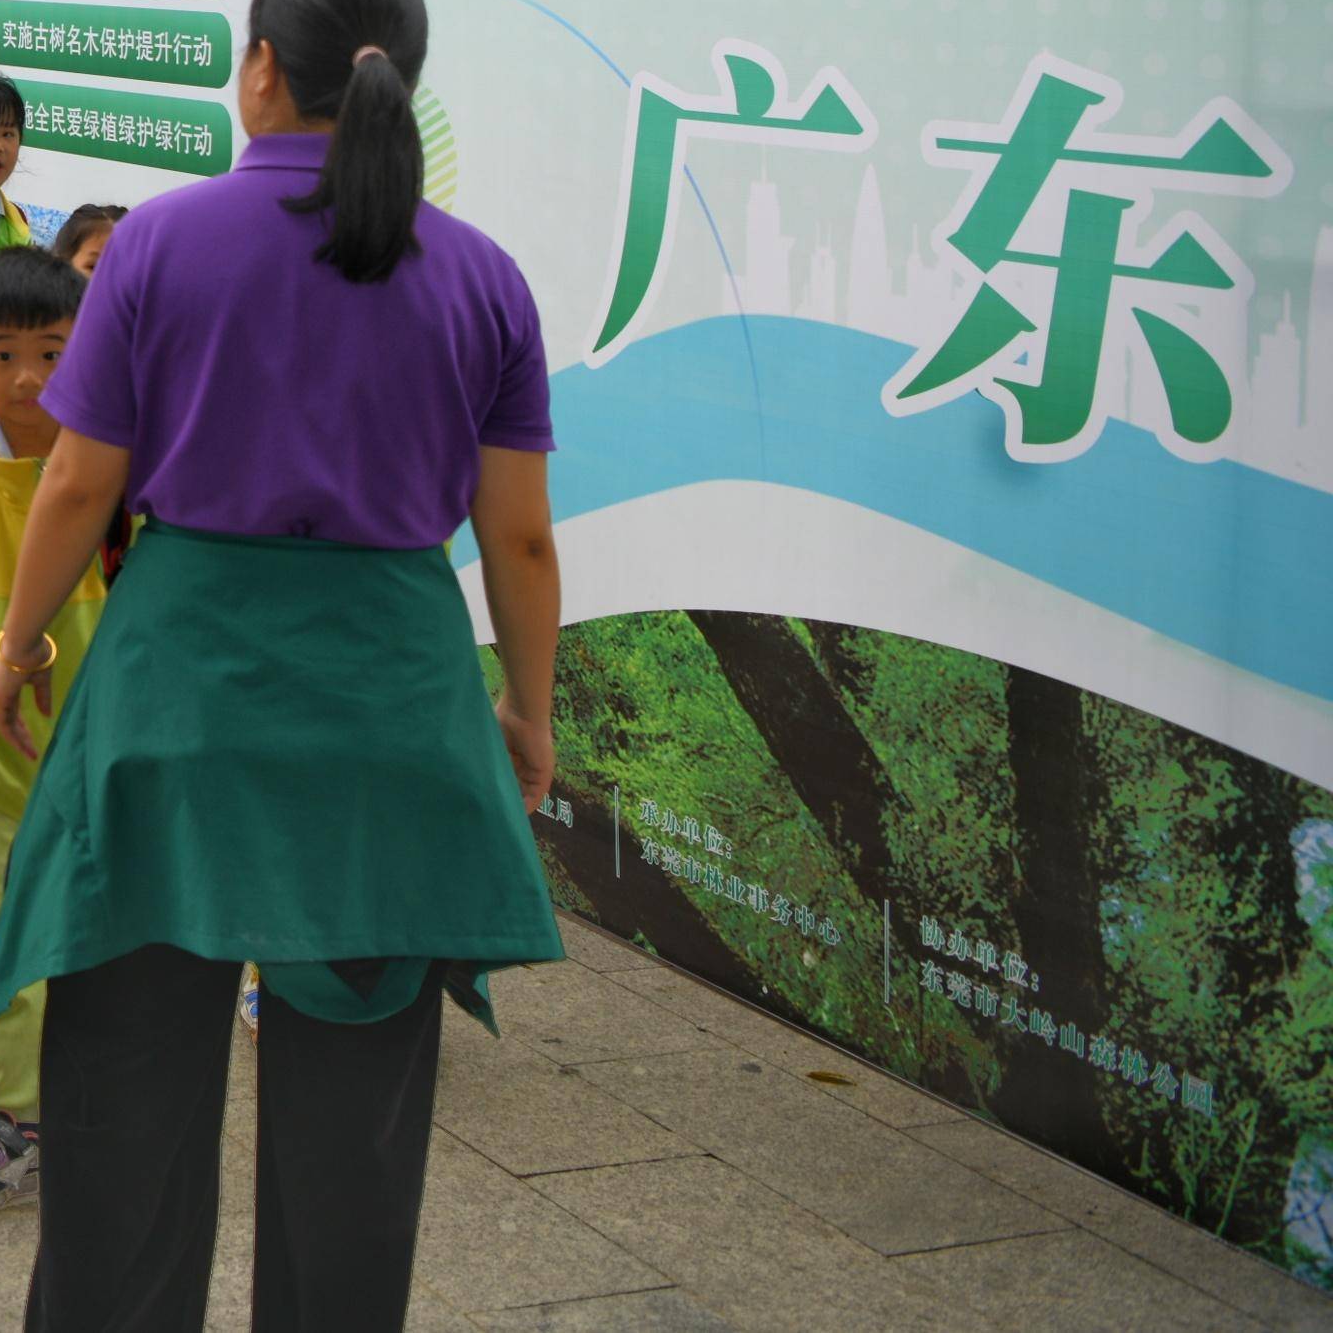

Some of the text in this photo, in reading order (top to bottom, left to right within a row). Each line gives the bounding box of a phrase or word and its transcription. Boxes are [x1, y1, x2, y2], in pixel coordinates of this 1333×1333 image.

[2, 19, 212, 67] 实施古树名木保护提升行动
[588, 46, 1279, 454] 广东
[640, 835, 843, 947] 东莞市林业事务中心
[919, 959, 1214, 1117] 东莞市大岭山森林公园
